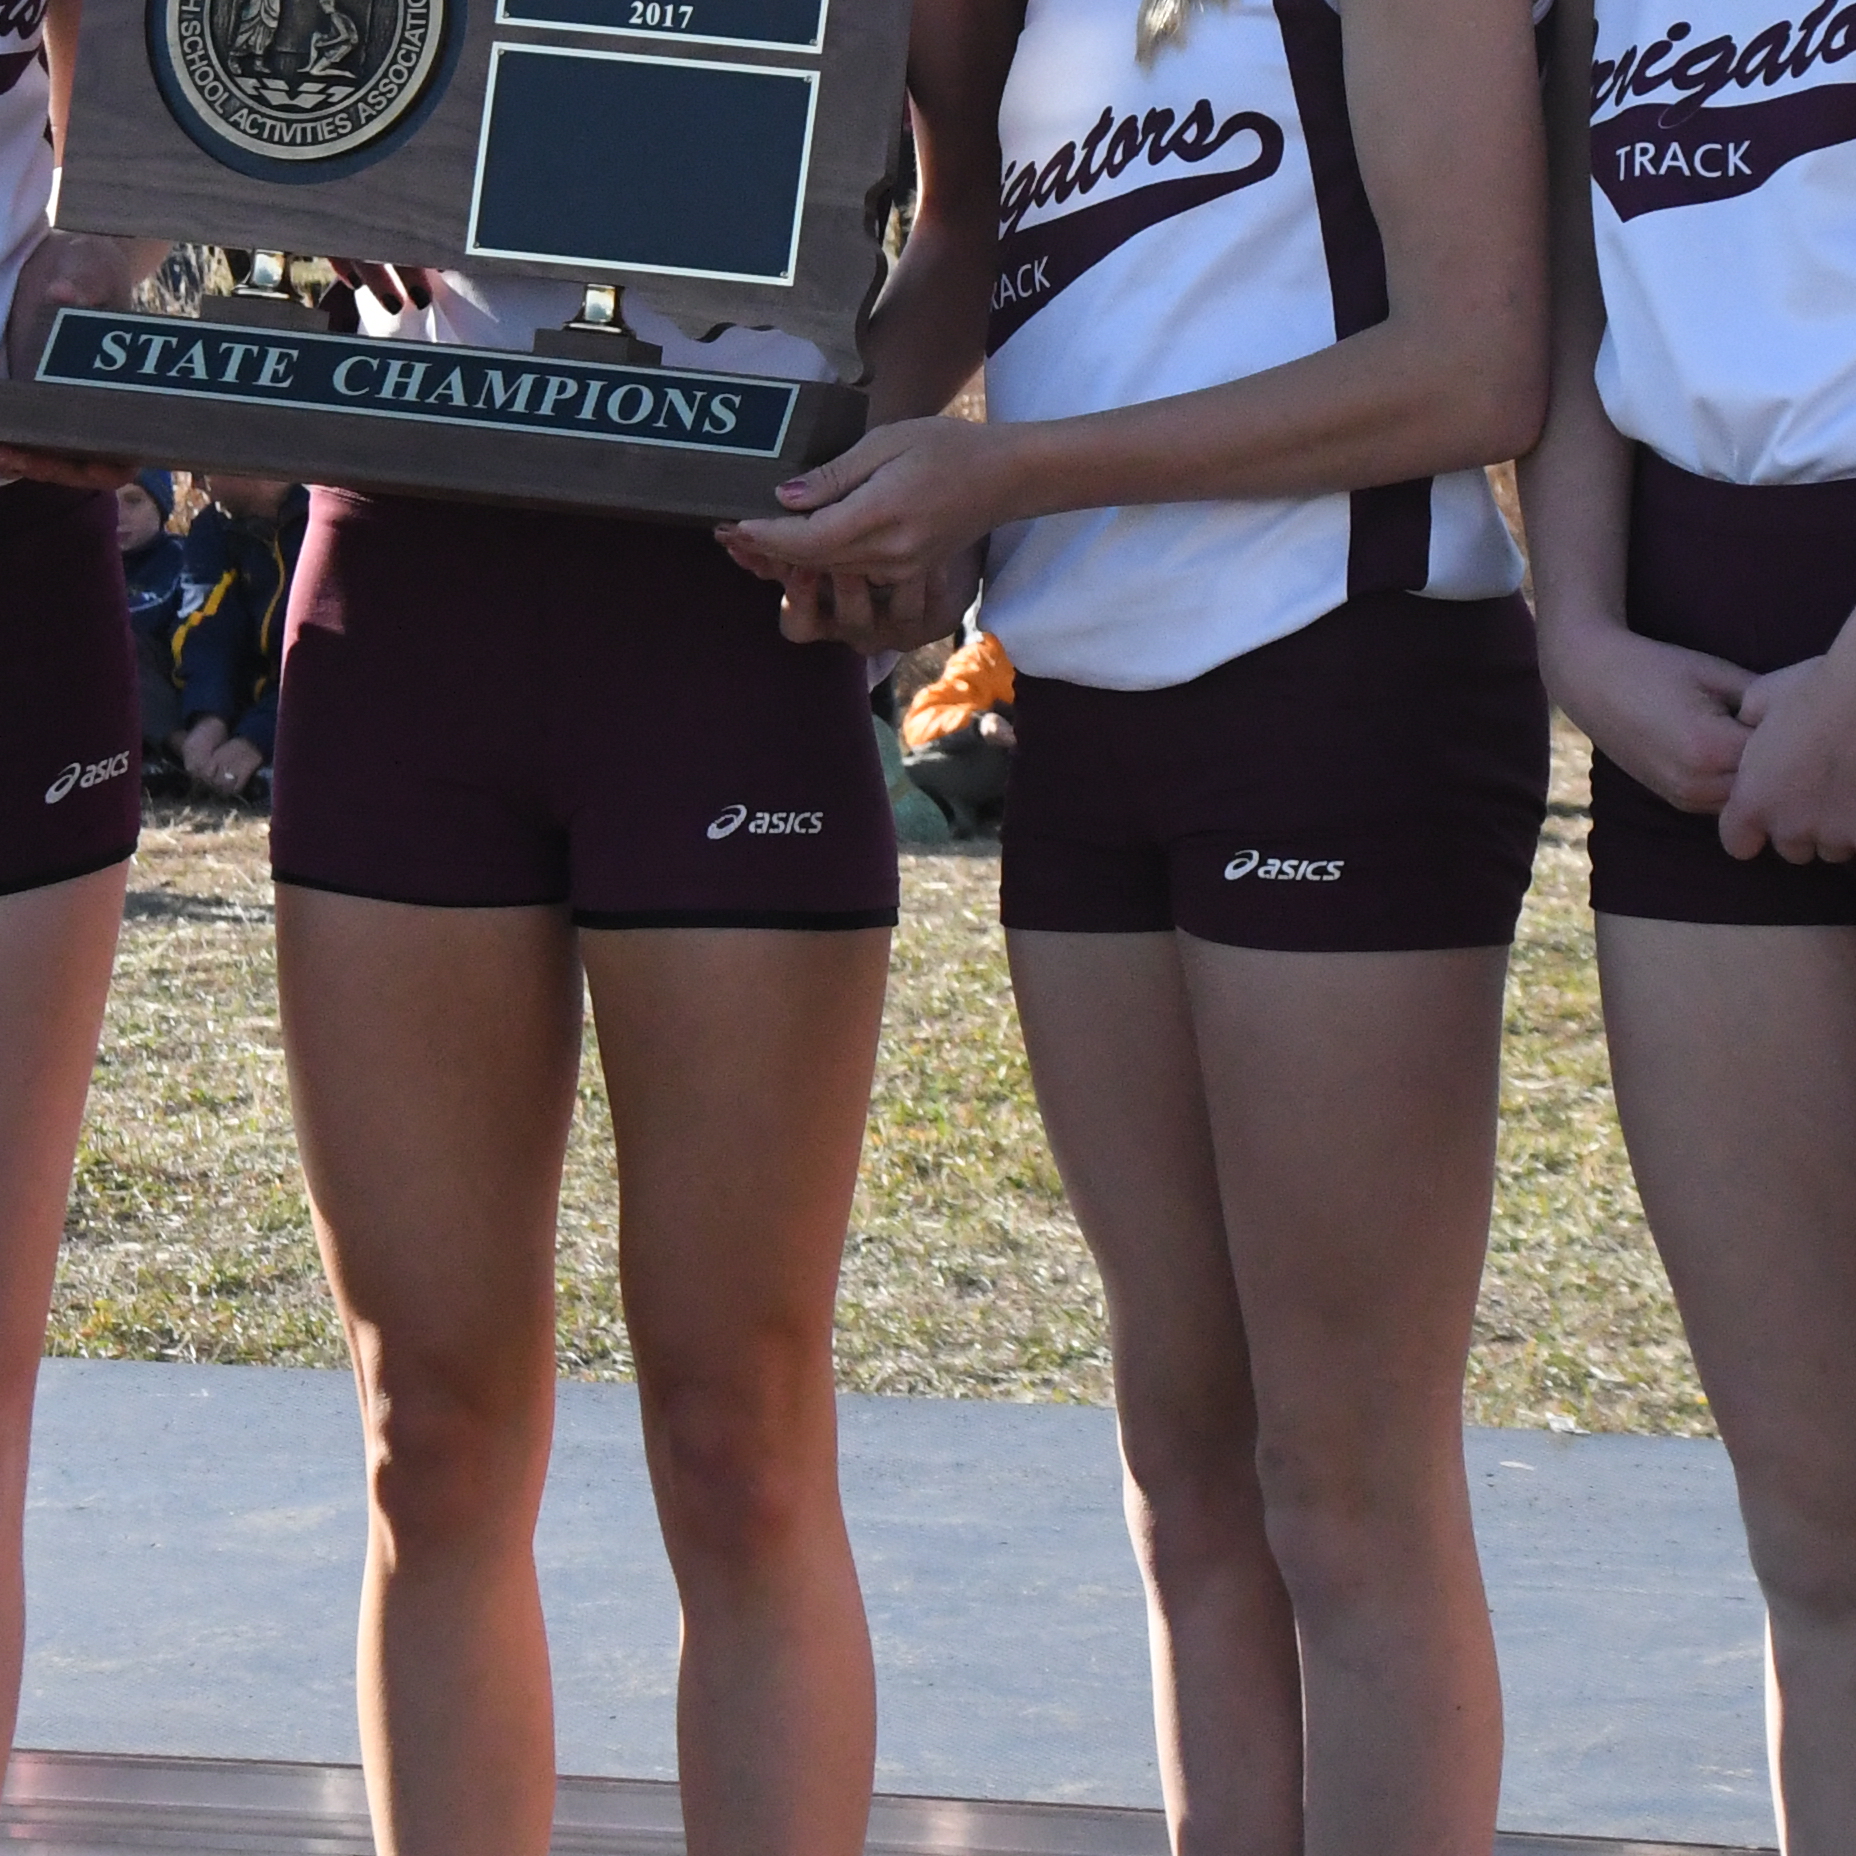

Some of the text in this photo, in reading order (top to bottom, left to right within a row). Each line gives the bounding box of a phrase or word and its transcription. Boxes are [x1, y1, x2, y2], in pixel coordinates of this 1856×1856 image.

[628, 1, 694, 28] 2017
[180, 18, 229, 114] SCHOOL
[229, 107, 353, 144] ACTIVITIES
[1615, 140, 1753, 182] TRACK
[92, 329, 742, 434] STATE CHAMPIONS
